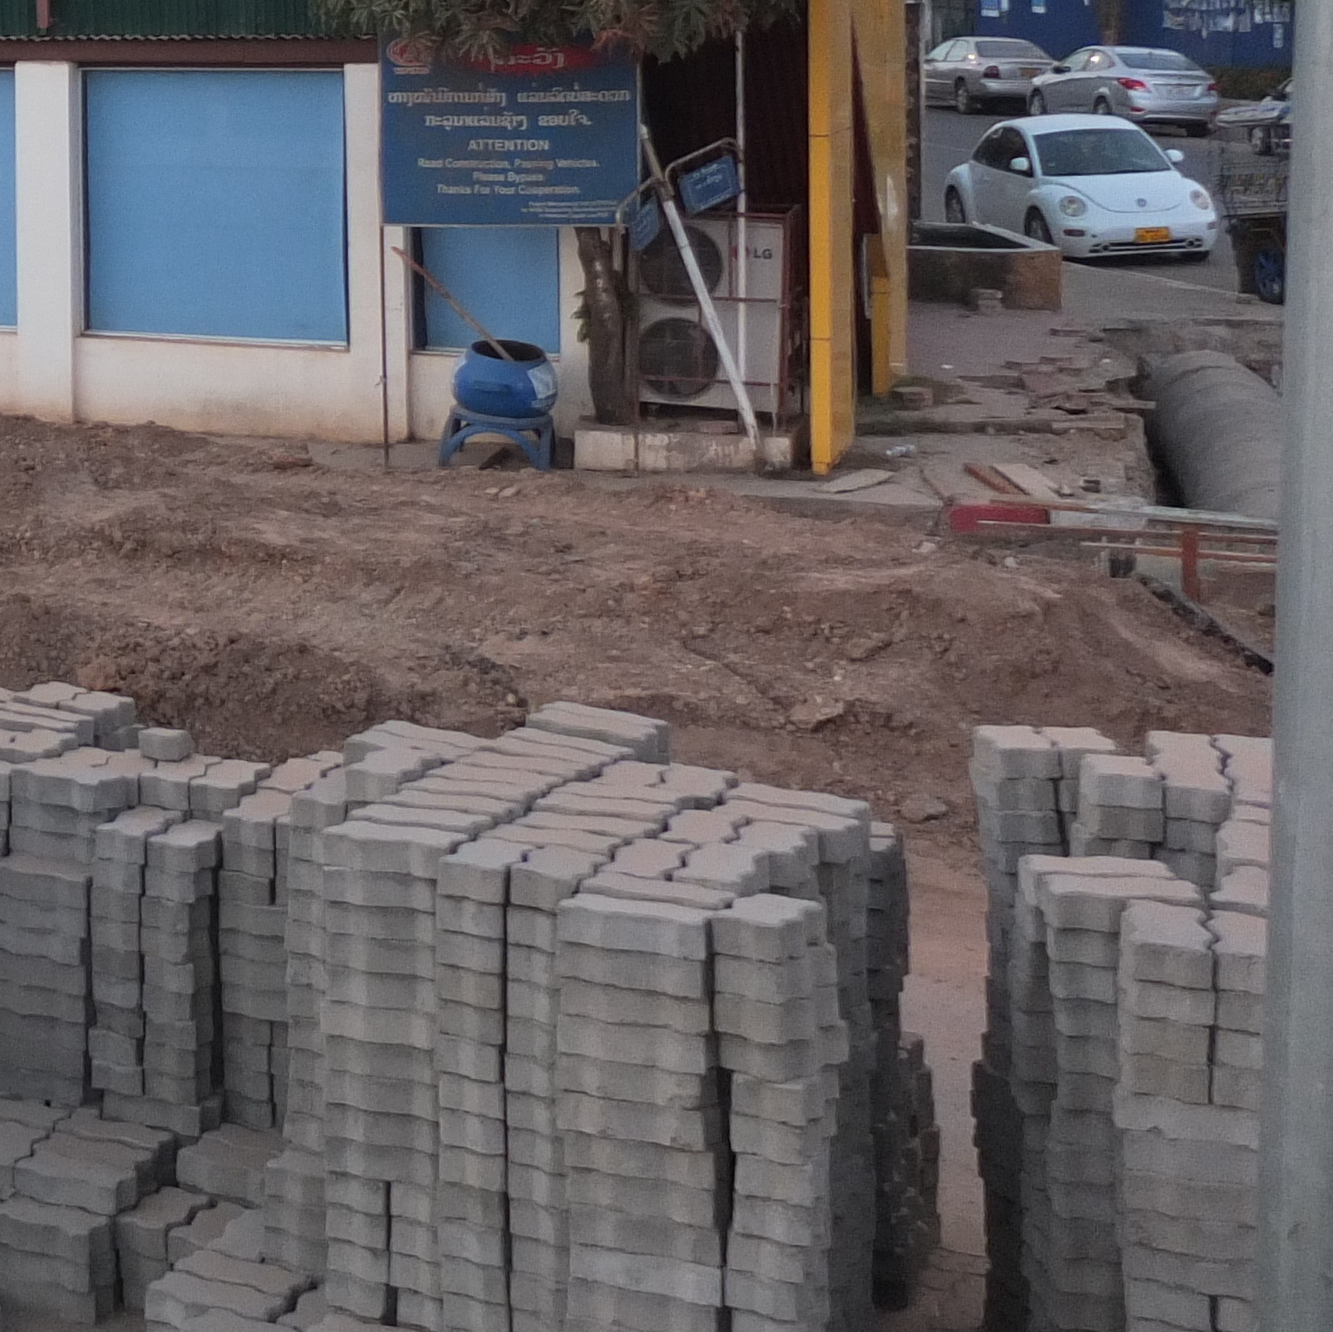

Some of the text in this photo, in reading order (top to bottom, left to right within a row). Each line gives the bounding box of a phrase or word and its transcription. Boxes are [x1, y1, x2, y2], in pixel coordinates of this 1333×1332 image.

[467, 139, 549, 151] ATTENTION
[417, 157, 444, 168] Road
[472, 171, 505, 182] Please
[437, 184, 472, 194] Thanks
[473, 184, 490, 194] For
[493, 184, 516, 194] Your
[753, 248, 773, 259] LG
